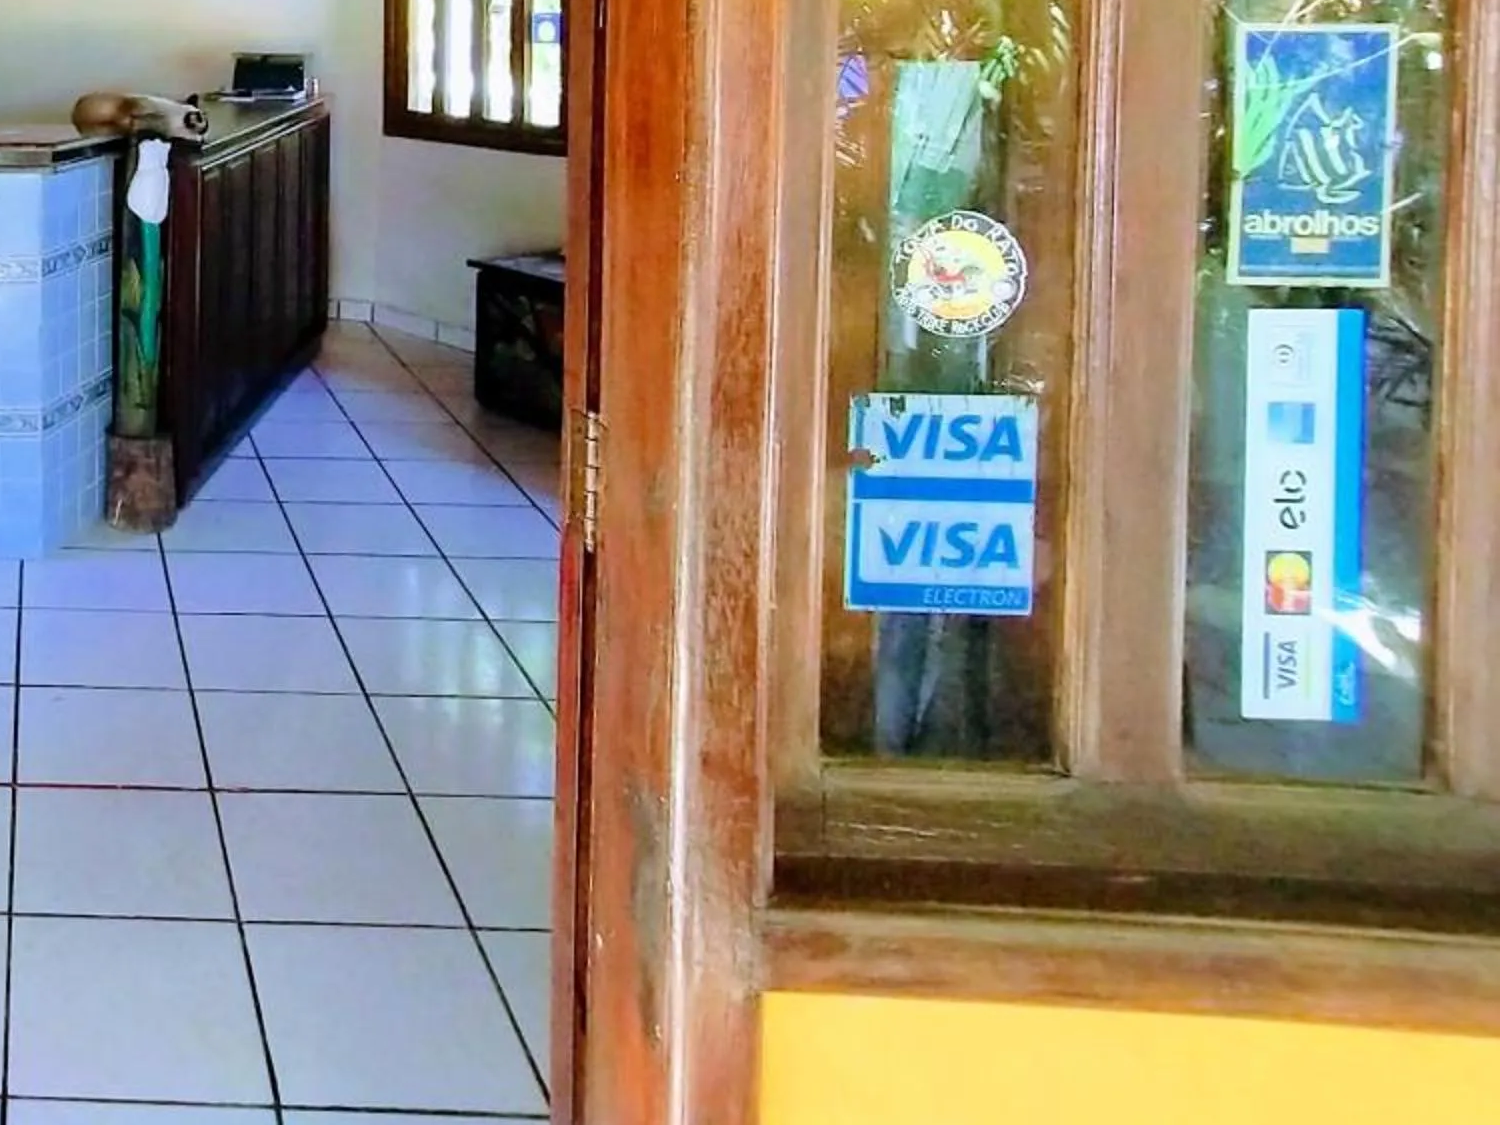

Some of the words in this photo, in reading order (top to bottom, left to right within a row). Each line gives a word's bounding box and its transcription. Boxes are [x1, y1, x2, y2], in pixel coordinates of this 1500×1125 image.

[951, 215, 978, 231] DO
[986, 225, 1019, 274] RATO
[1243, 209, 1380, 236] abrolhos
[881, 413, 1023, 462] VISA
[1273, 470, 1307, 530] elo
[878, 520, 1020, 569] VISA
[923, 587, 1022, 606] ELECTRON
[1277, 640, 1298, 690] VISA
